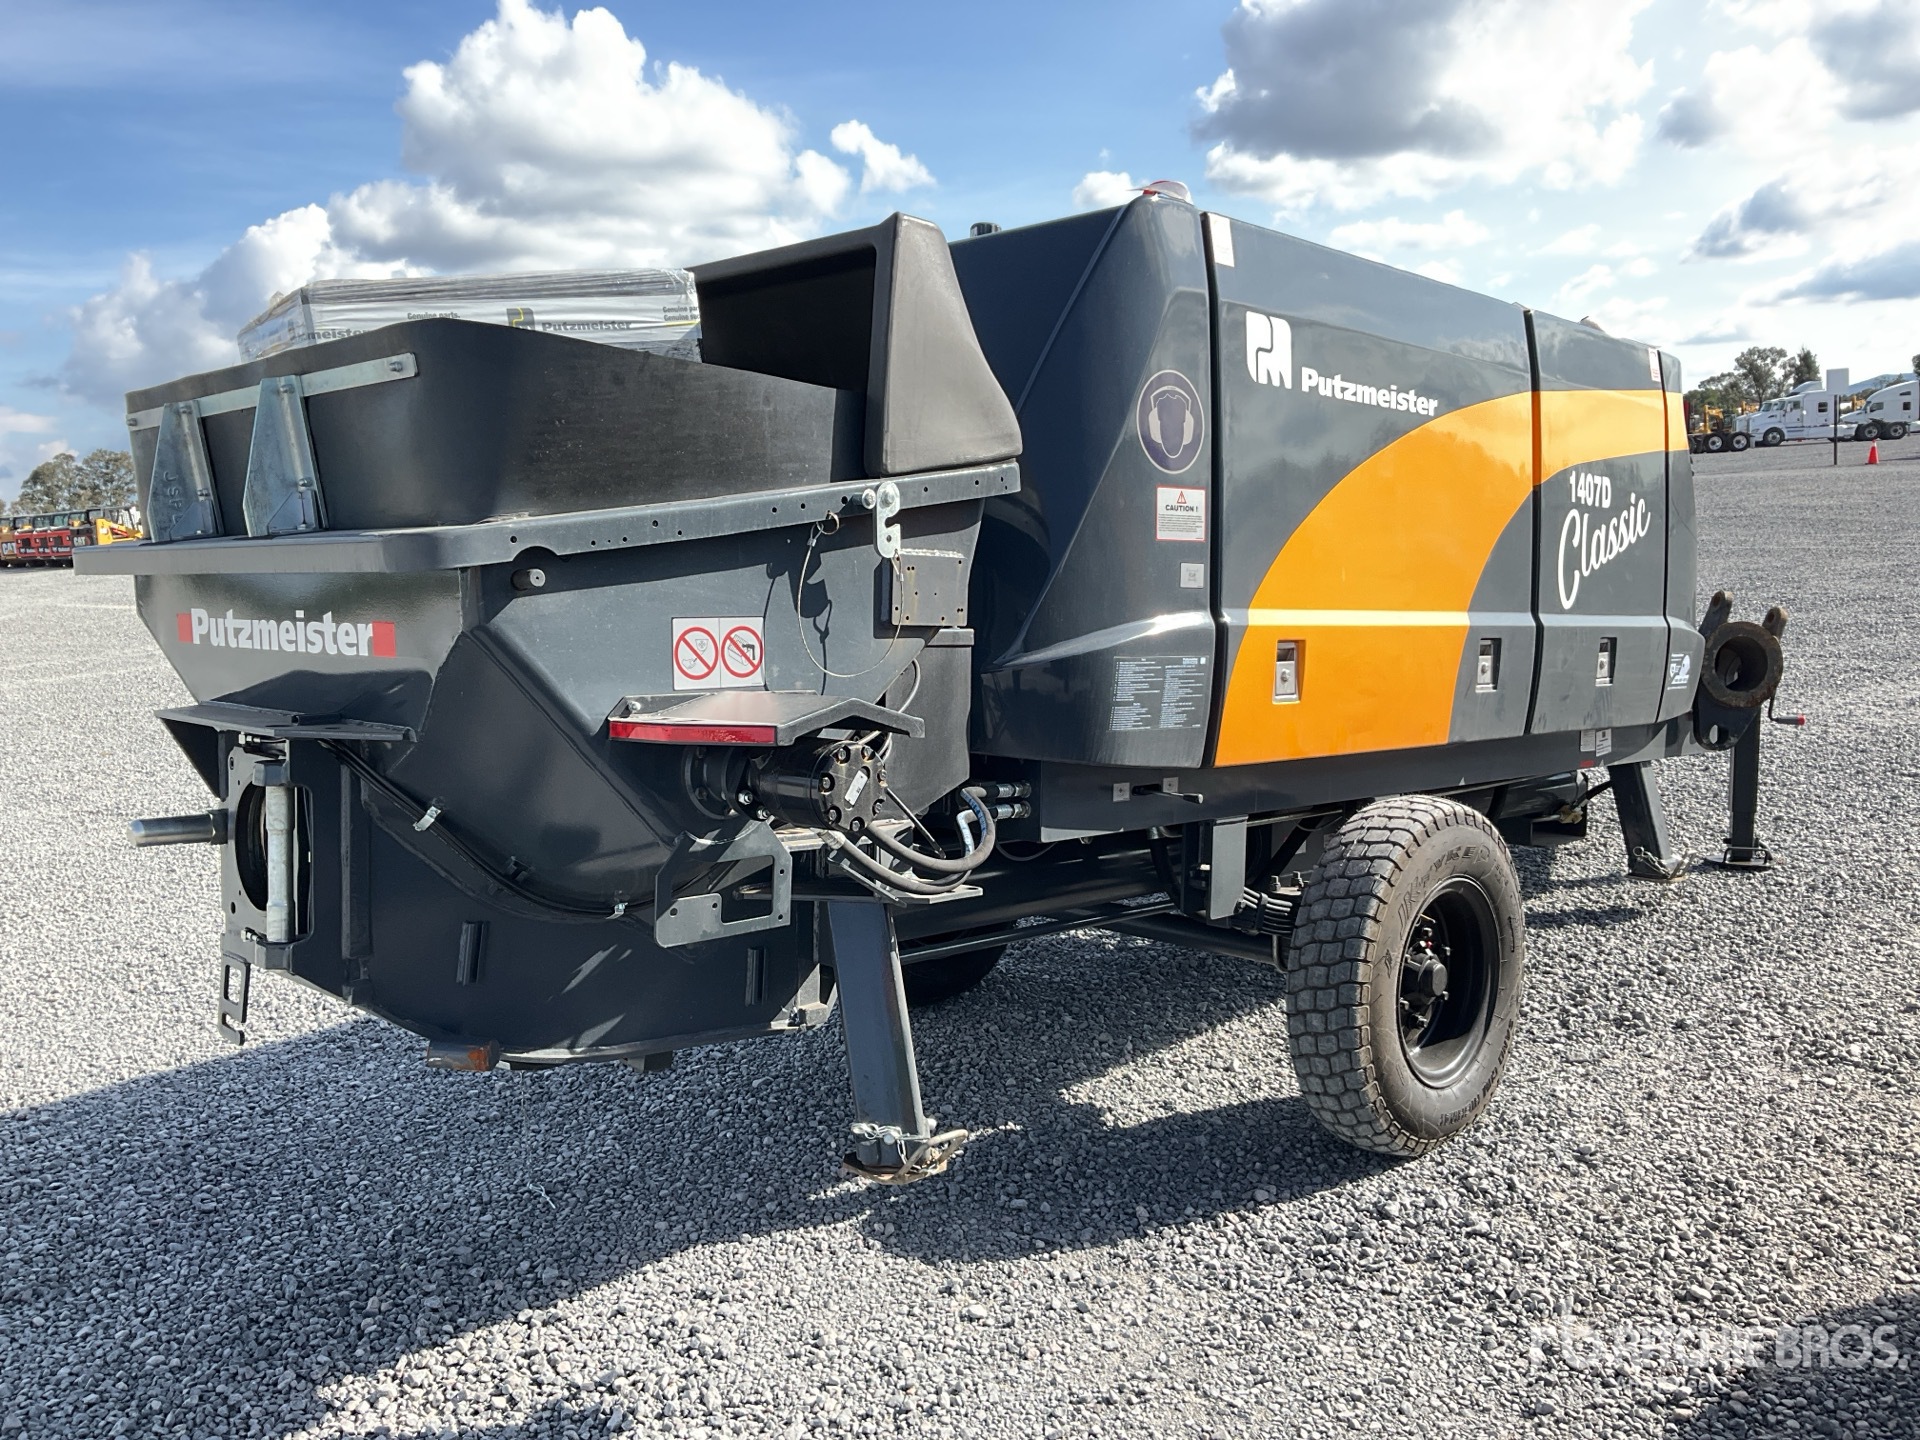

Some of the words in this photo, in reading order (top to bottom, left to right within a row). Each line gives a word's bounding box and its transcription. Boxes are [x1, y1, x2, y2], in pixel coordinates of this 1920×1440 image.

[541, 321, 632, 332] Putzmeister
[1301, 367, 1438, 417] Putzmeister
[1569, 470, 1612, 509] 1407D
[1165, 504, 1194, 512] CAUTION
[2, 542, 17, 555] CAT
[74, 536, 86, 546] CAT
[1557, 492, 1651, 610] Classic
[190, 608, 373, 656] Putzmeister
